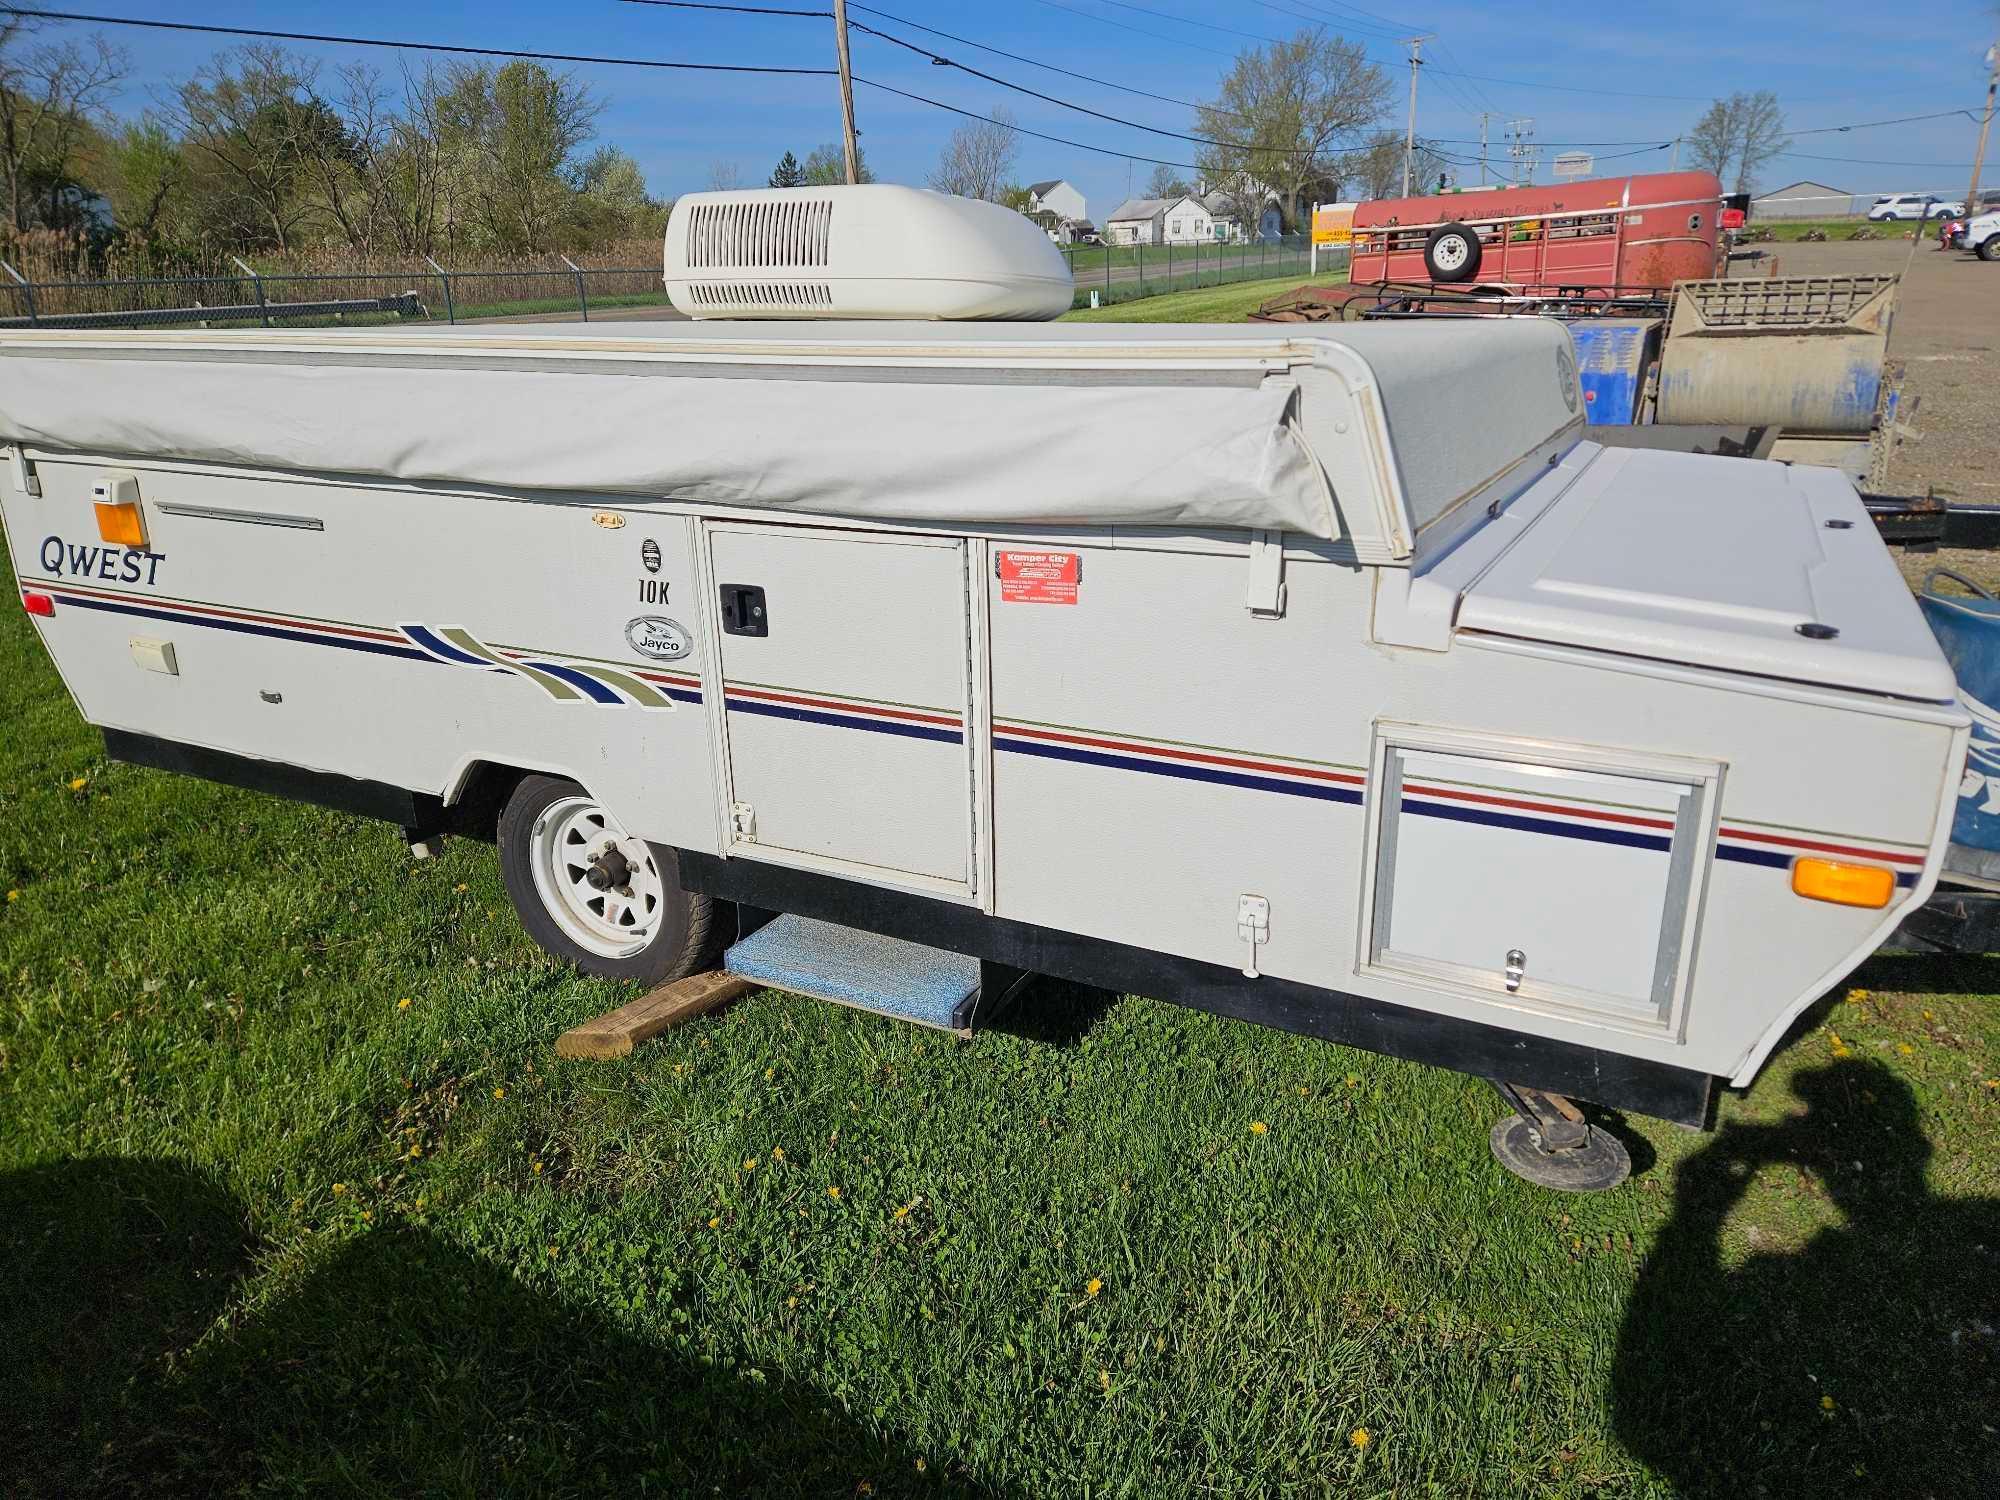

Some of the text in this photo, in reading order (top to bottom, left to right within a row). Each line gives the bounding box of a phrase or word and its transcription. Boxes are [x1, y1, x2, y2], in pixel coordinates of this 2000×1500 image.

[40, 535, 166, 586] QWEST
[1007, 553, 1045, 563] Kamper
[639, 578, 670, 605] 10K
[639, 636, 680, 651] Jayco
